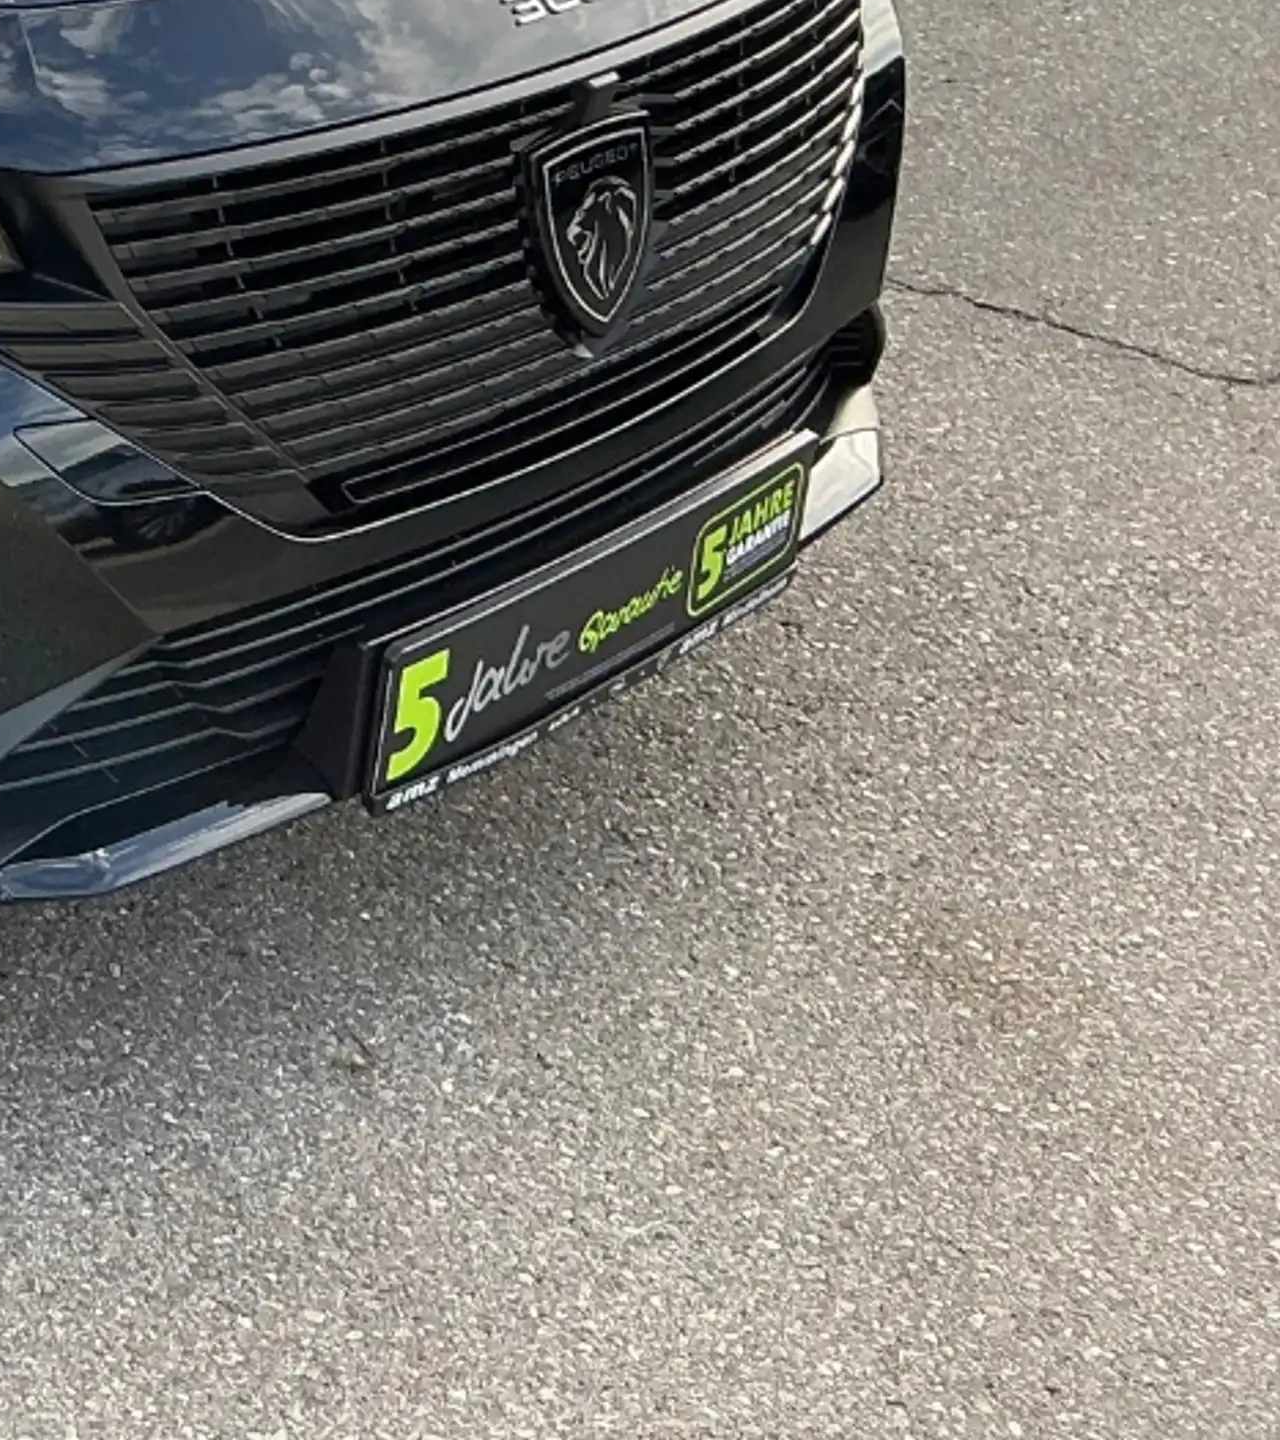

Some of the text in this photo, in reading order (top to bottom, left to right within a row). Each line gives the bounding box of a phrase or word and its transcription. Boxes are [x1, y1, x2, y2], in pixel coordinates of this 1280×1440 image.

[553, 141, 639, 187] PEUGEOT
[697, 523, 728, 601] 5
[728, 479, 796, 546] JAHRE
[386, 647, 450, 782] 5
[443, 623, 571, 743] Jahre
[578, 564, 683, 654] Garantie
